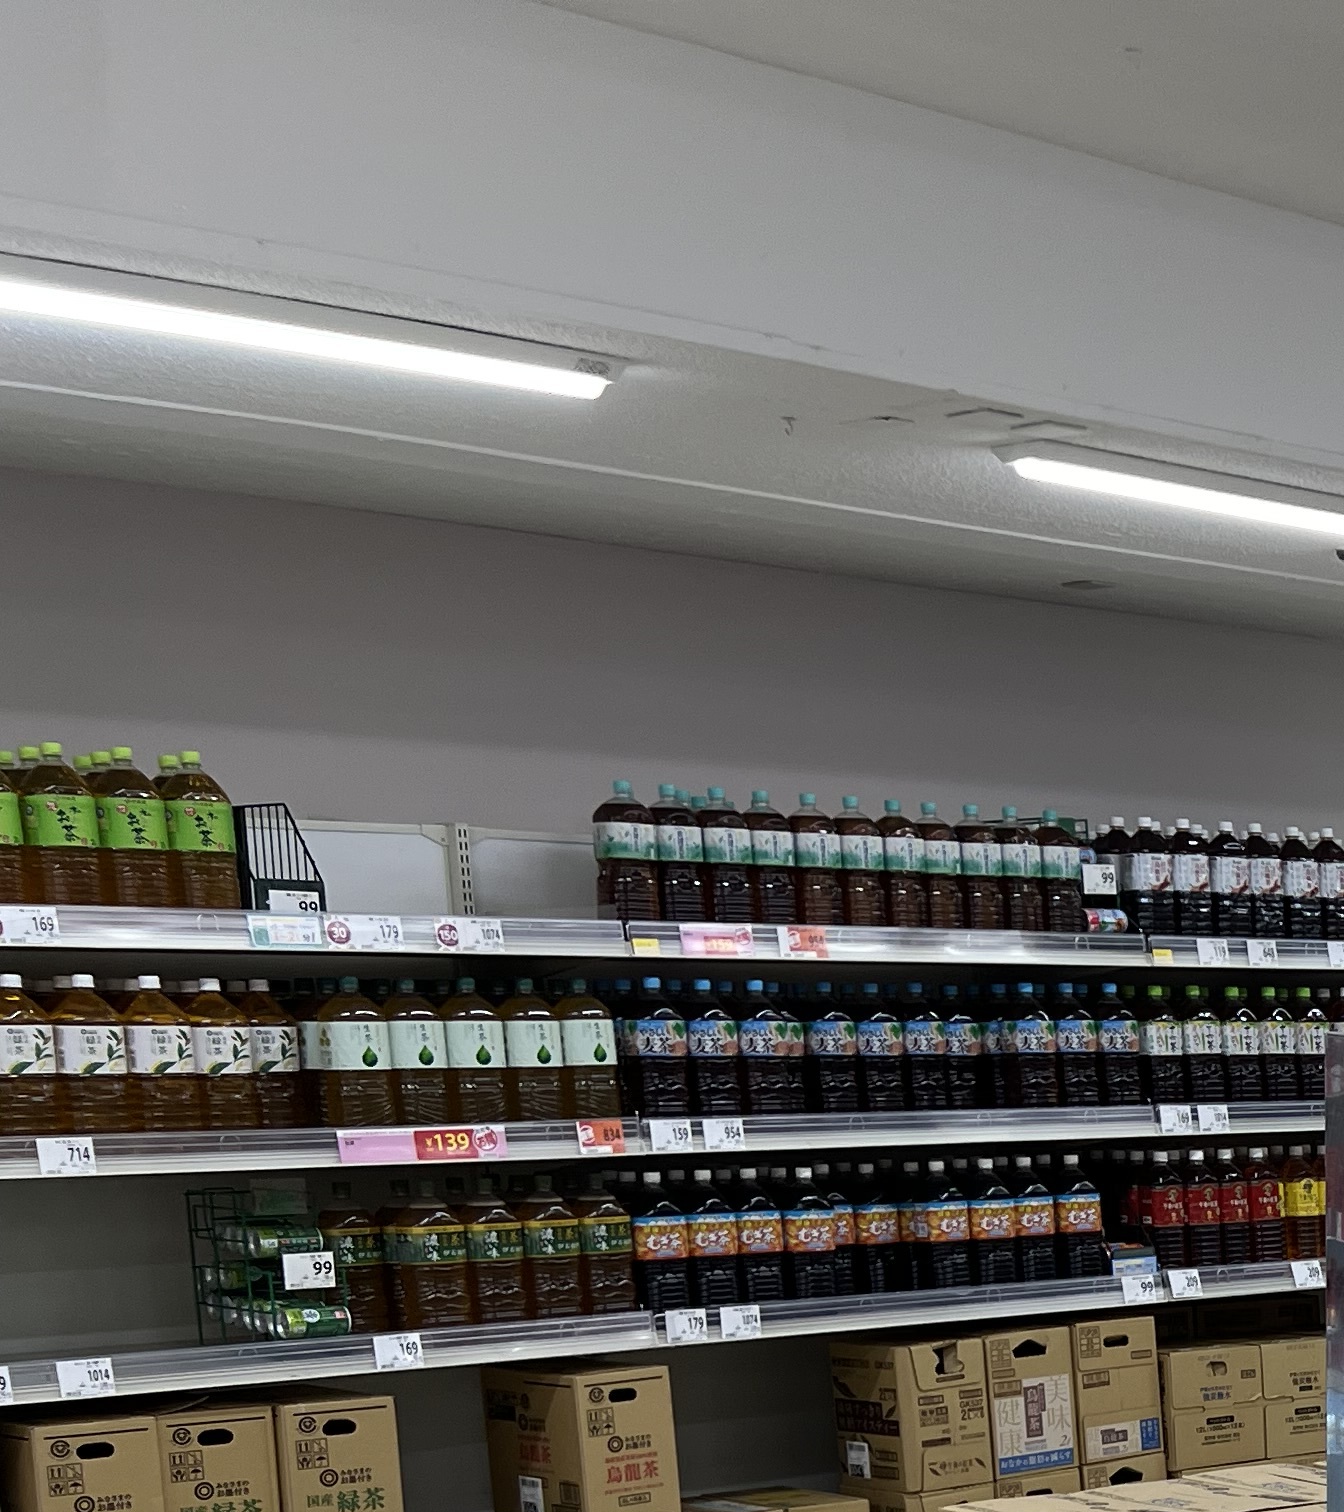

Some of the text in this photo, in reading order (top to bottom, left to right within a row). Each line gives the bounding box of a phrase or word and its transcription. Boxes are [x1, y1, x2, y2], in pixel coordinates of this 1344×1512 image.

[1101, 871, 1114, 886] 99
[31, 916, 55, 932] 169
[380, 924, 399, 939] 179
[329, 927, 347, 939] 30
[438, 929, 459, 942] 150
[425, 1131, 471, 1152] ¥139
[672, 1126, 690, 1142] 159
[67, 1147, 91, 1162] 714
[312, 1260, 333, 1277] 99
[1139, 1281, 1154, 1293] 99
[687, 1316, 705, 1331] 179
[399, 1341, 419, 1356] 169
[87, 1368, 111, 1382] 1014
[1047, 1374, 1071, 1430] 美味
[997, 1400, 1023, 1455] 健康
[606, 1460, 660, 1485] 烏龍茶
[305, 1492, 335, 1509] 国産
